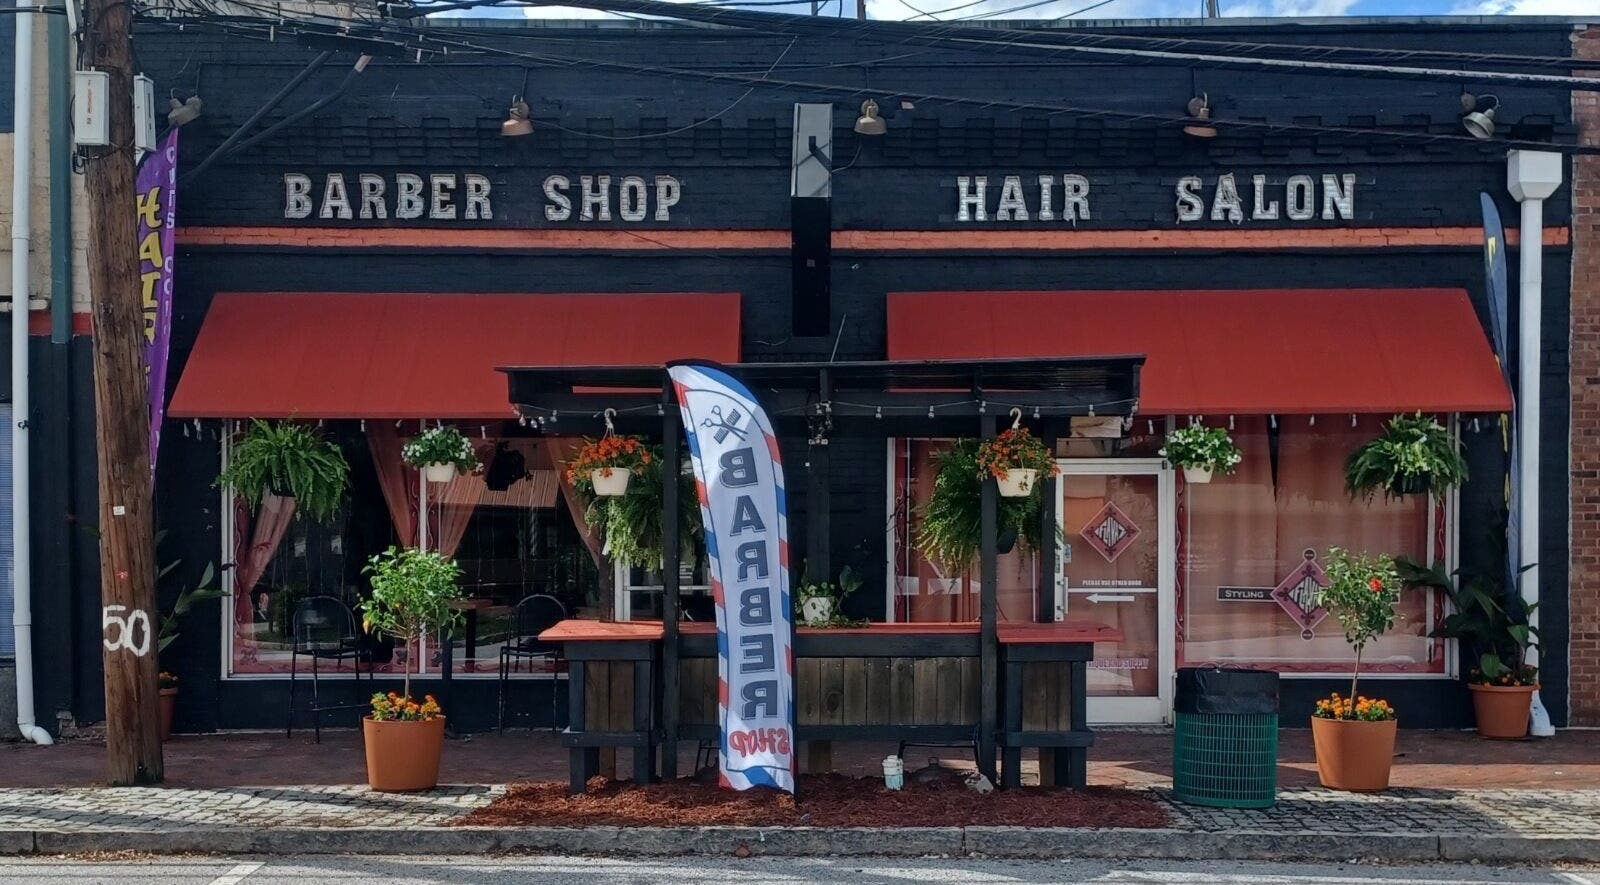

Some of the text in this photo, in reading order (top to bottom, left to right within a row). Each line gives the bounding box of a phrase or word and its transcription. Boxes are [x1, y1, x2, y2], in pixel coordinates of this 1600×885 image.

[284, 173, 681, 221] BARBER SHOP
[957, 173, 1356, 223] HAIR SALON
[103, 605, 151, 657] 50
